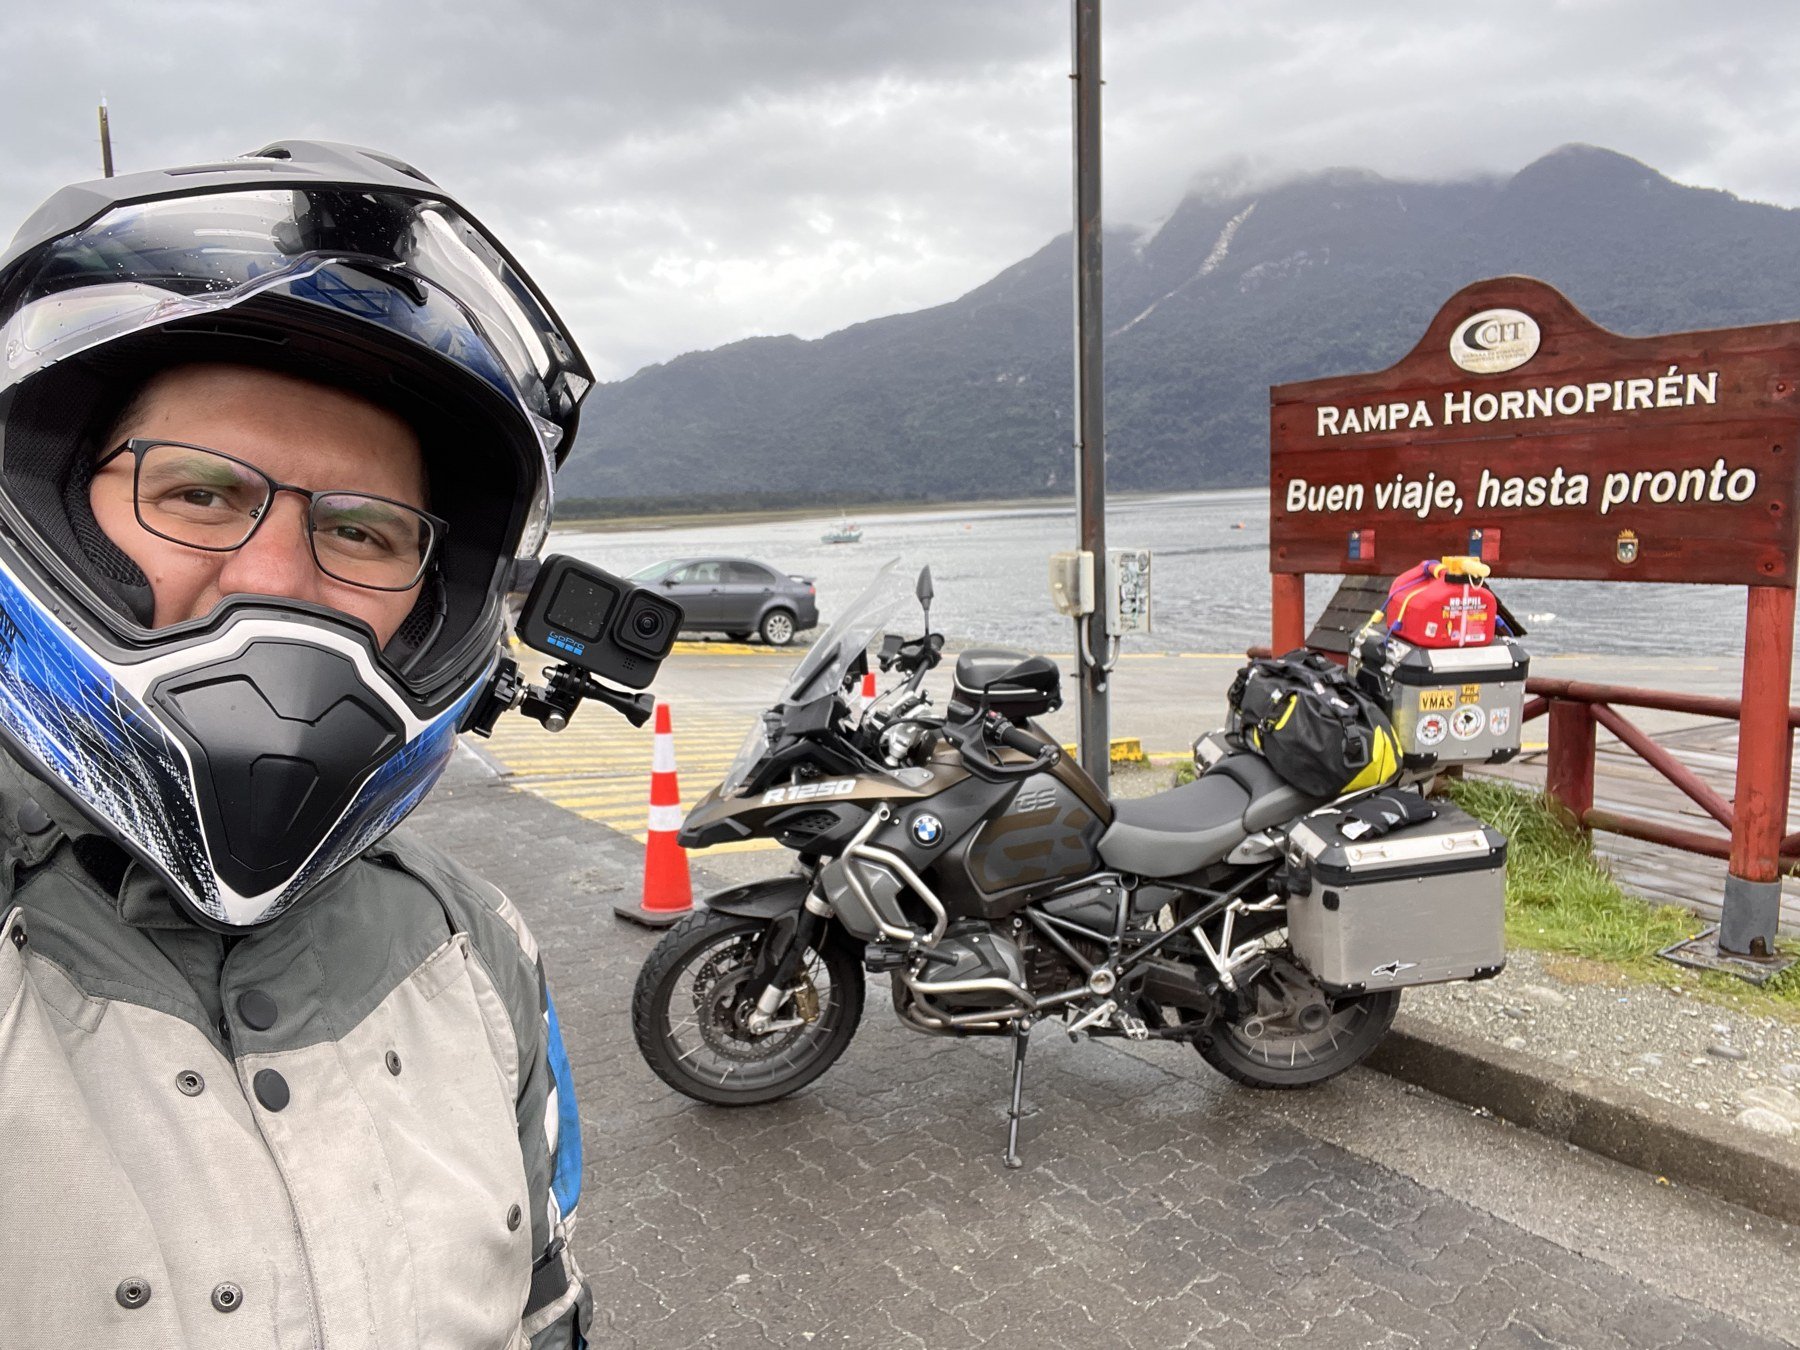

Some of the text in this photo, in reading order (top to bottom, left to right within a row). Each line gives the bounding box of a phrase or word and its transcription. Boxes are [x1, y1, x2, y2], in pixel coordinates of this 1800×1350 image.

[1317, 365, 1718, 437] RAMPA HORNOPIRÉN
[1286, 458, 1756, 519] Buen viaje, hasta pronto
[549, 630, 585, 650] GoPro
[1014, 787, 1057, 813] GS
